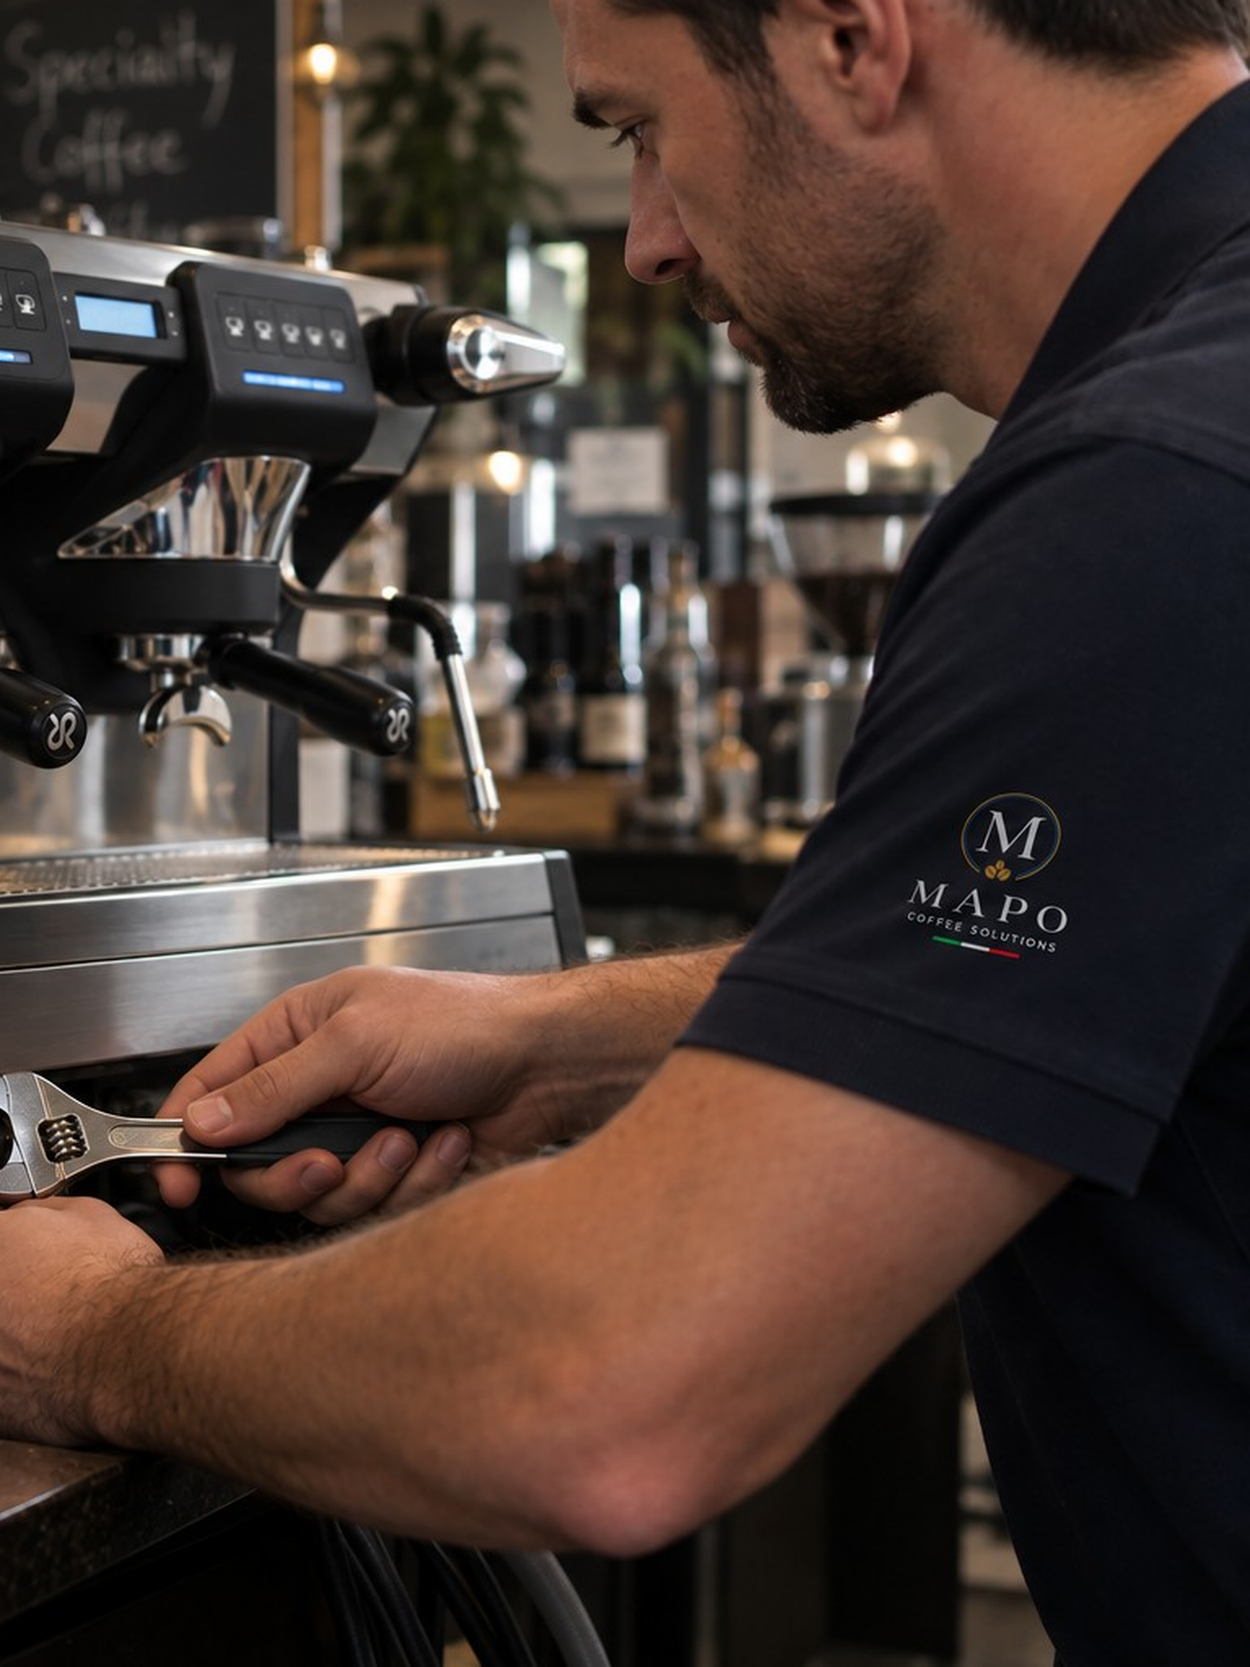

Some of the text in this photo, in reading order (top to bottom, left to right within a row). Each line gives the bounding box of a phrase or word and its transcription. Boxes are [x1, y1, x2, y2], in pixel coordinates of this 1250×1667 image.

[21, 108, 192, 194] Coffee
[976, 810, 1047, 861] M
[907, 879, 1068, 934] MAPO
[907, 911, 1057, 953] COFFEE SOLUTIONS
